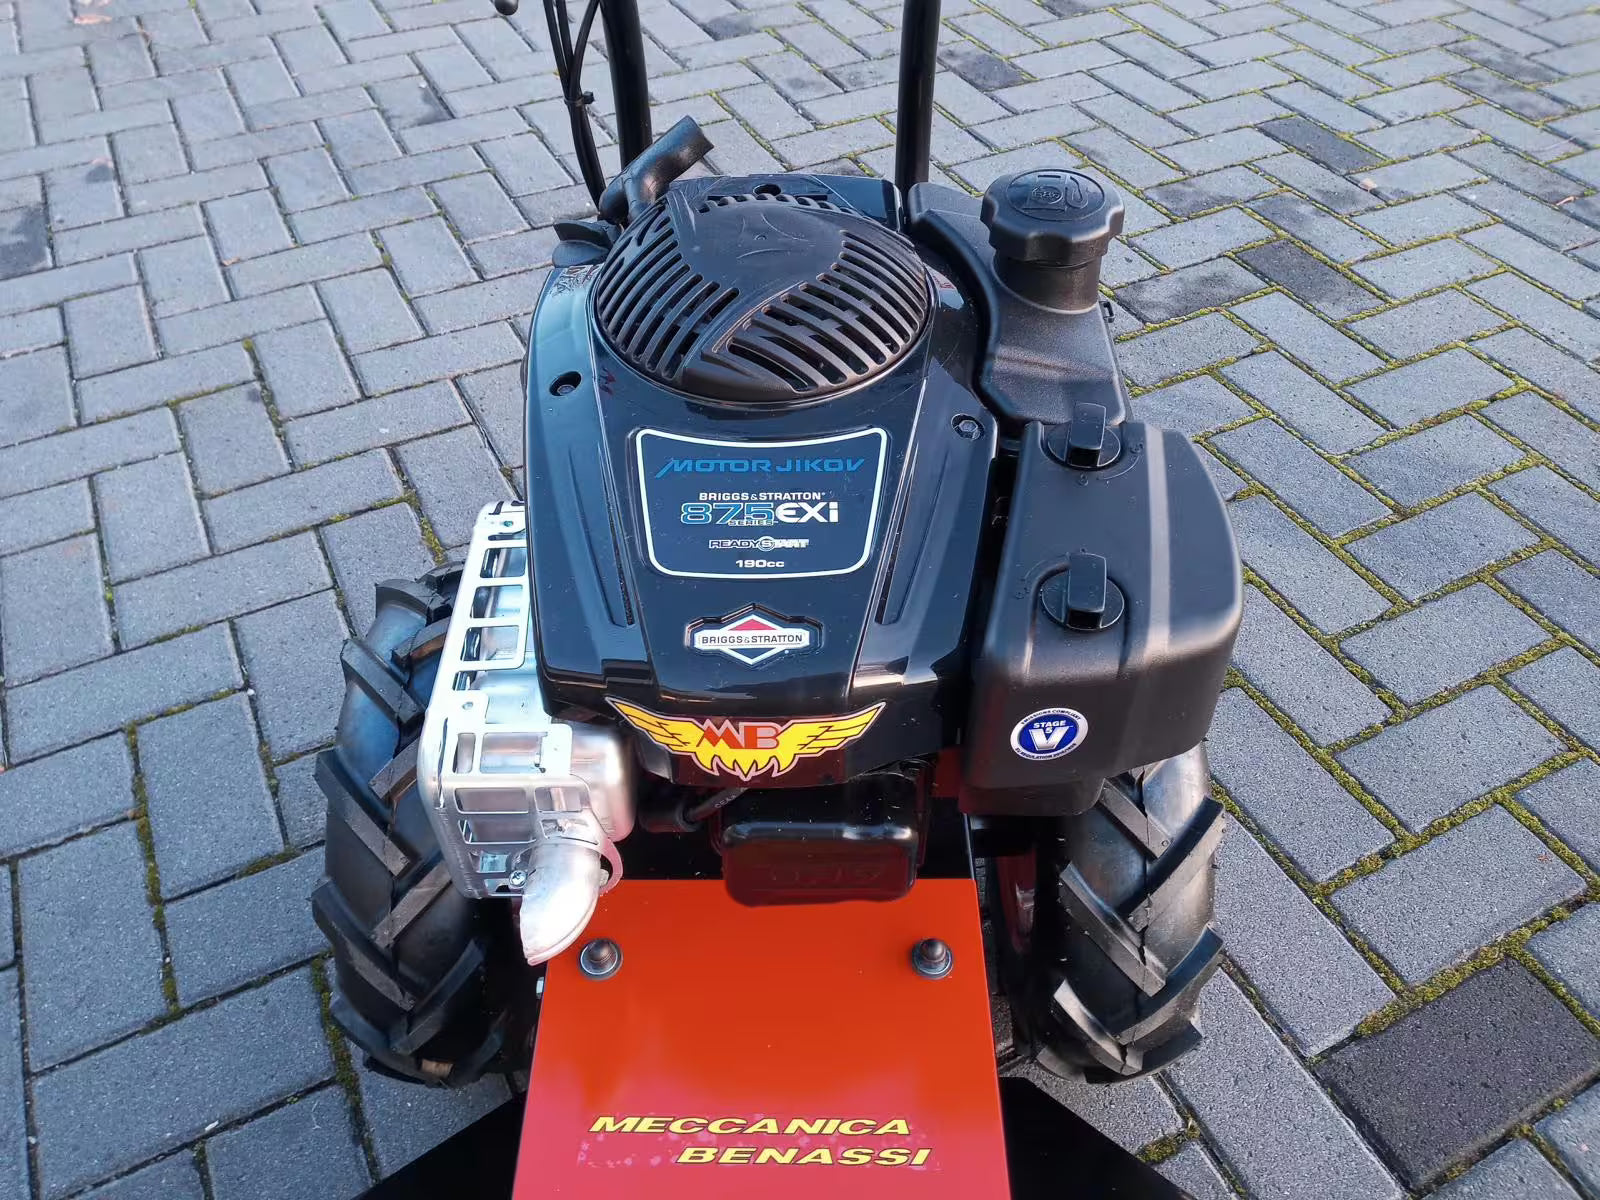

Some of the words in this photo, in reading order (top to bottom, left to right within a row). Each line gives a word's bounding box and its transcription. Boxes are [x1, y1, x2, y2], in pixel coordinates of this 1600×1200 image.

[655, 459, 771, 479] MOTOR
[776, 458, 865, 472] JIKOV
[735, 559, 785, 568] 190cc
[1033, 720, 1067, 729] STAGE
[588, 1116, 911, 1136] MECCANICA
[675, 1147, 933, 1166] BENASSI
